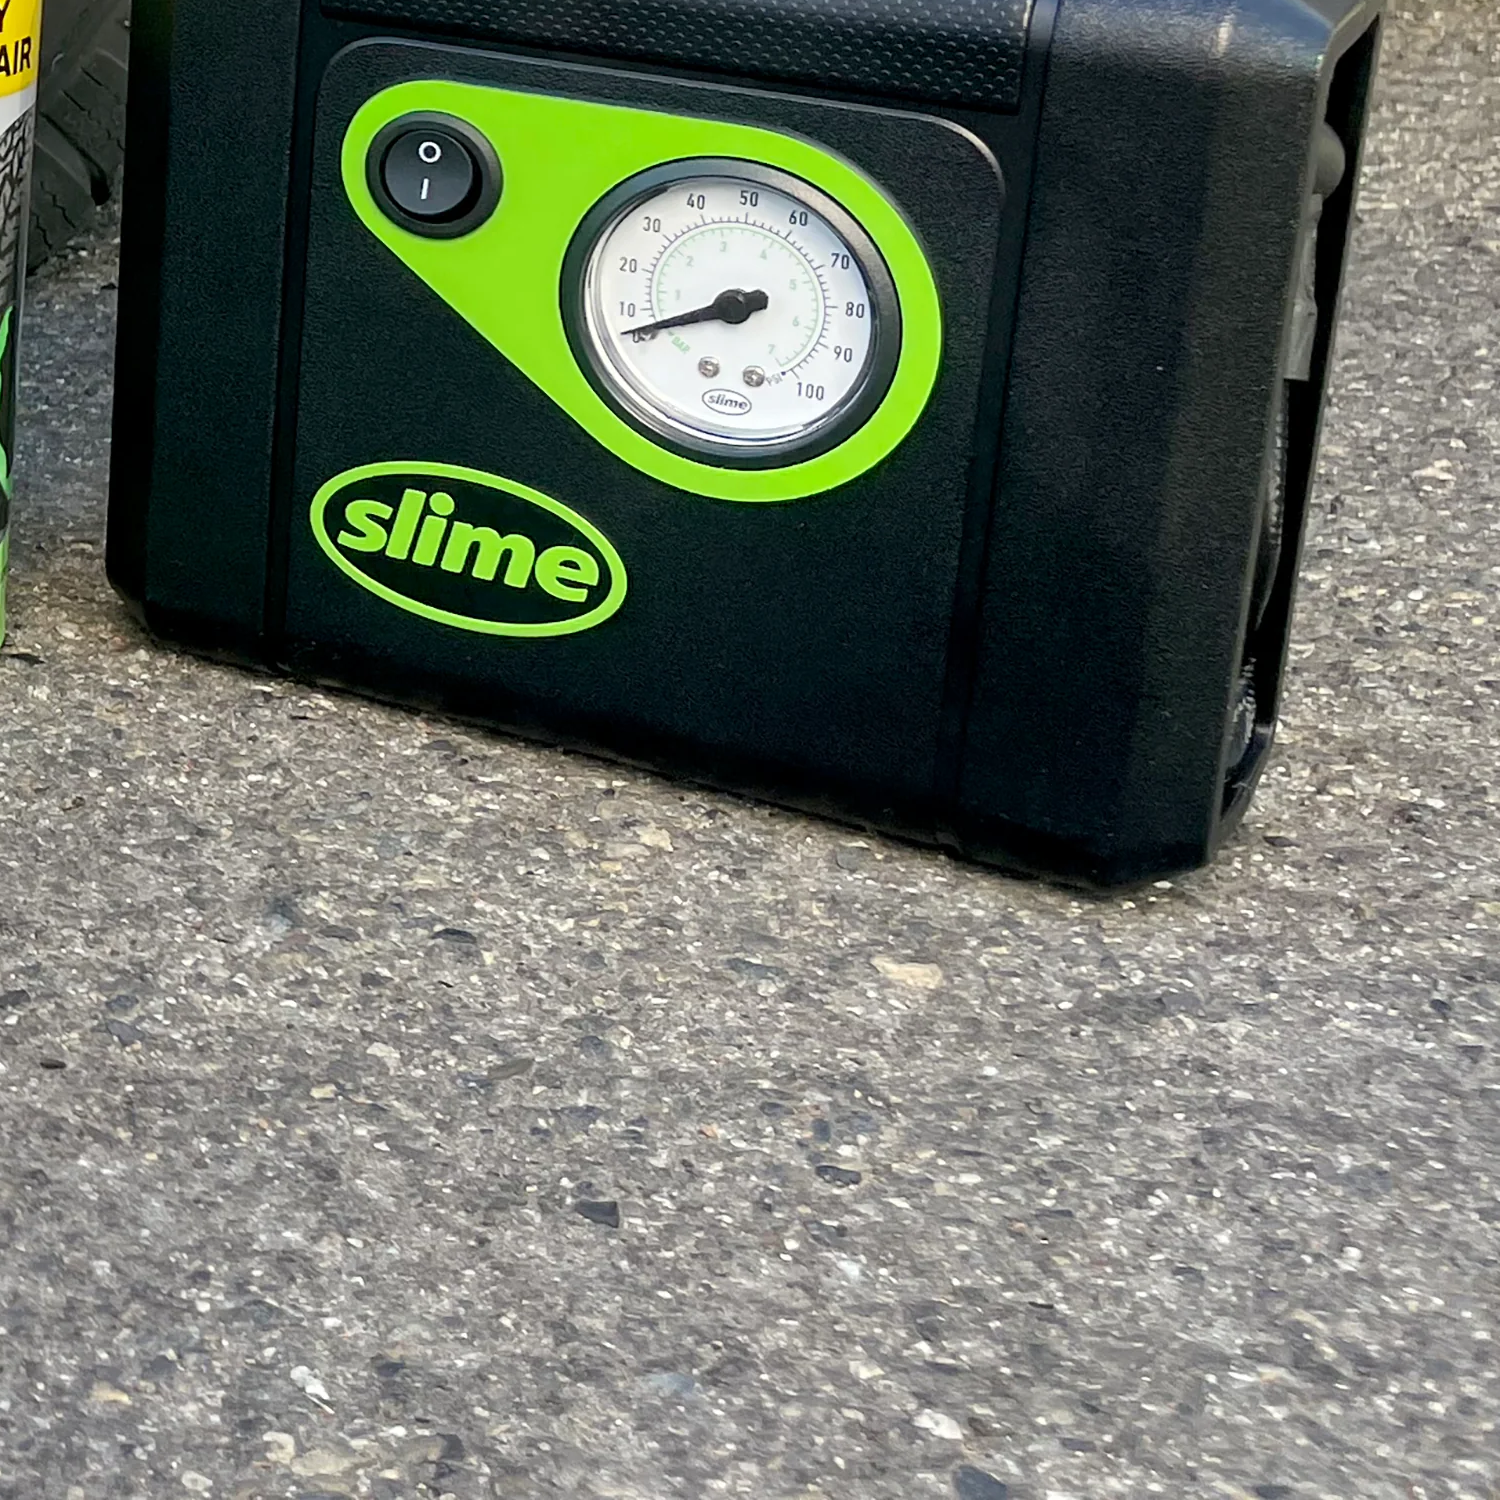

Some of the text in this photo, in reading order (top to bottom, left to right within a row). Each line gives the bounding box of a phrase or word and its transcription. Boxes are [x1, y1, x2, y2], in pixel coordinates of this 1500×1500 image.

[687, 193, 706, 211] 40
[739, 190, 759, 208] 50
[642, 216, 662, 233] 30
[789, 209, 809, 227] 60
[619, 256, 638, 273] 20
[831, 253, 851, 270] 70
[619, 301, 637, 318] 10
[845, 302, 865, 319] 80
[833, 345, 853, 363] 90
[796, 381, 825, 401] 100
[708, 392, 749, 410] slime
[337, 488, 600, 602] slime
